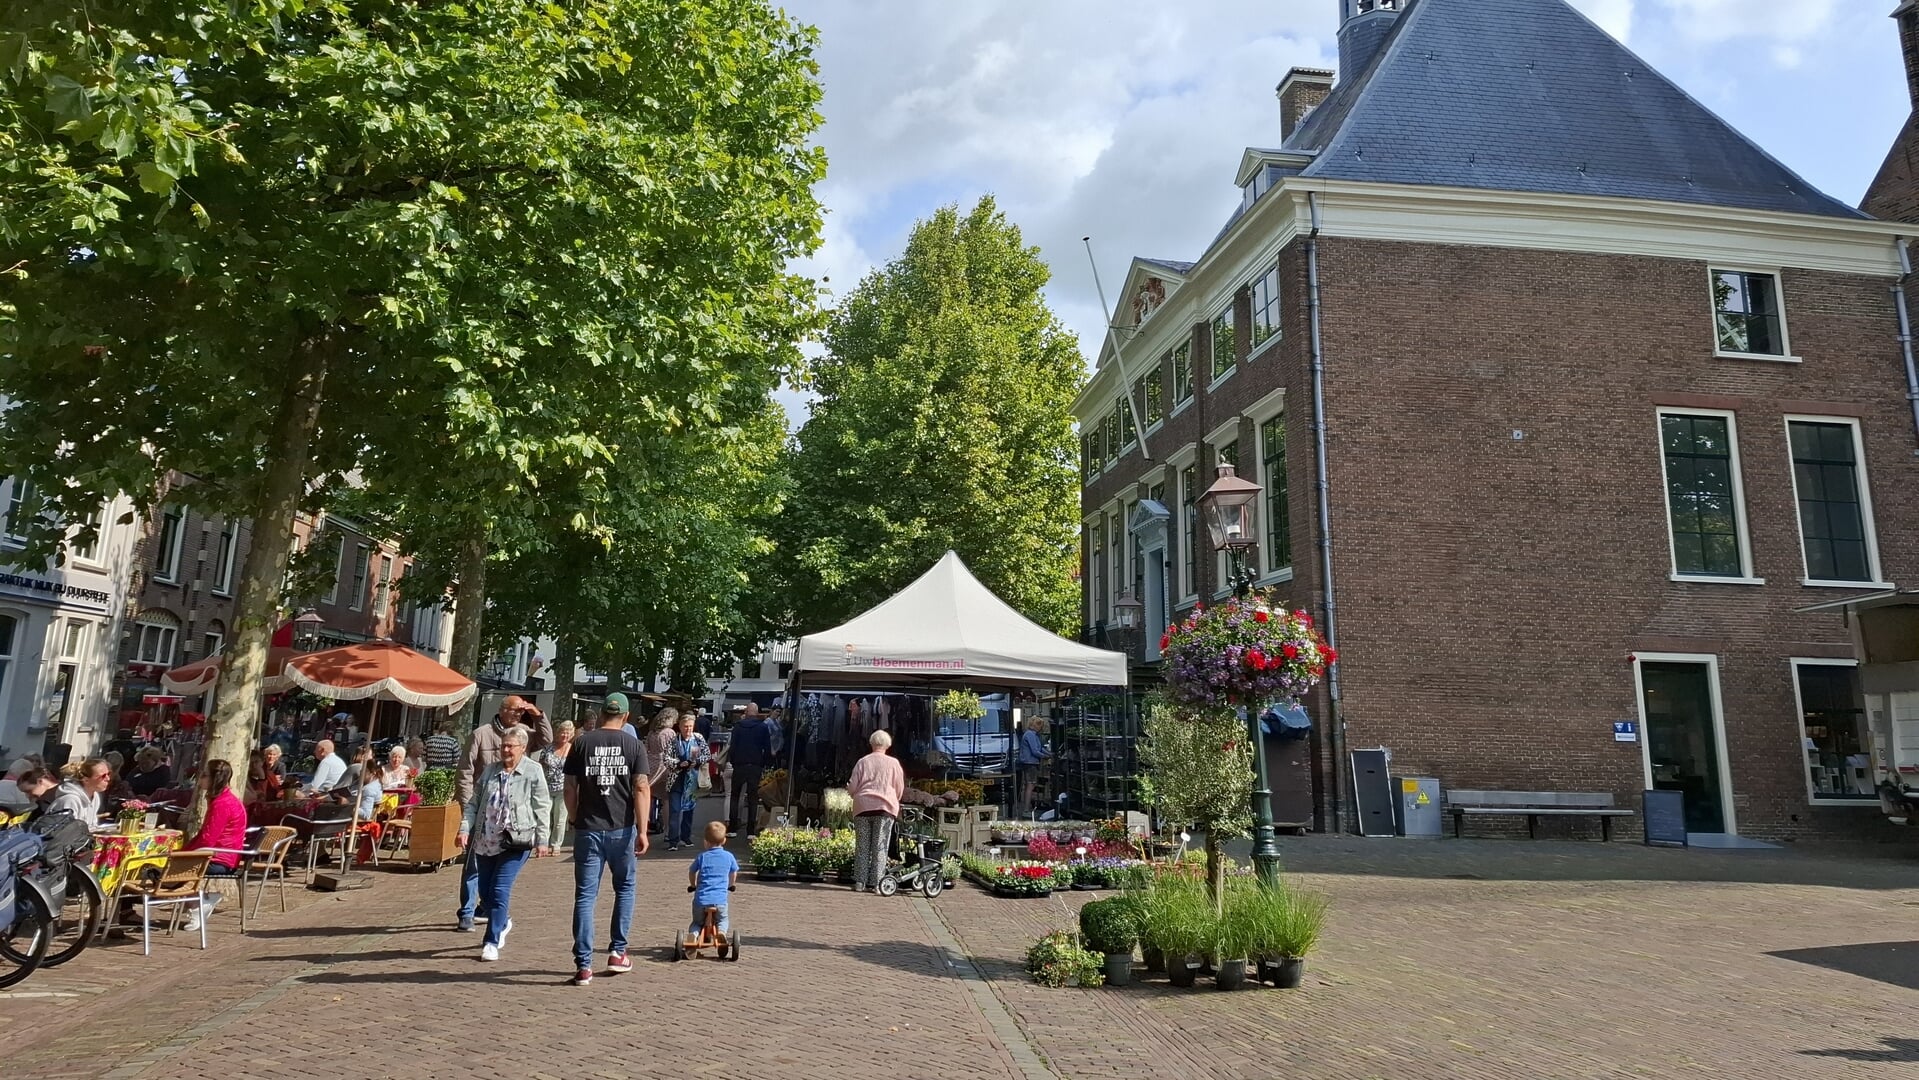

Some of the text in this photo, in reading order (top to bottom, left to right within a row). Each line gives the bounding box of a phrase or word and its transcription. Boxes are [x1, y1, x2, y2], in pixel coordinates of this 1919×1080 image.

[854, 656, 964, 669] Uwbloemenman.nl
[595, 746, 621, 756] UNITED
[589, 756, 625, 766] WE STAND
[585, 765, 628, 776] FOR BETTER
[597, 775, 616, 786] BEER
